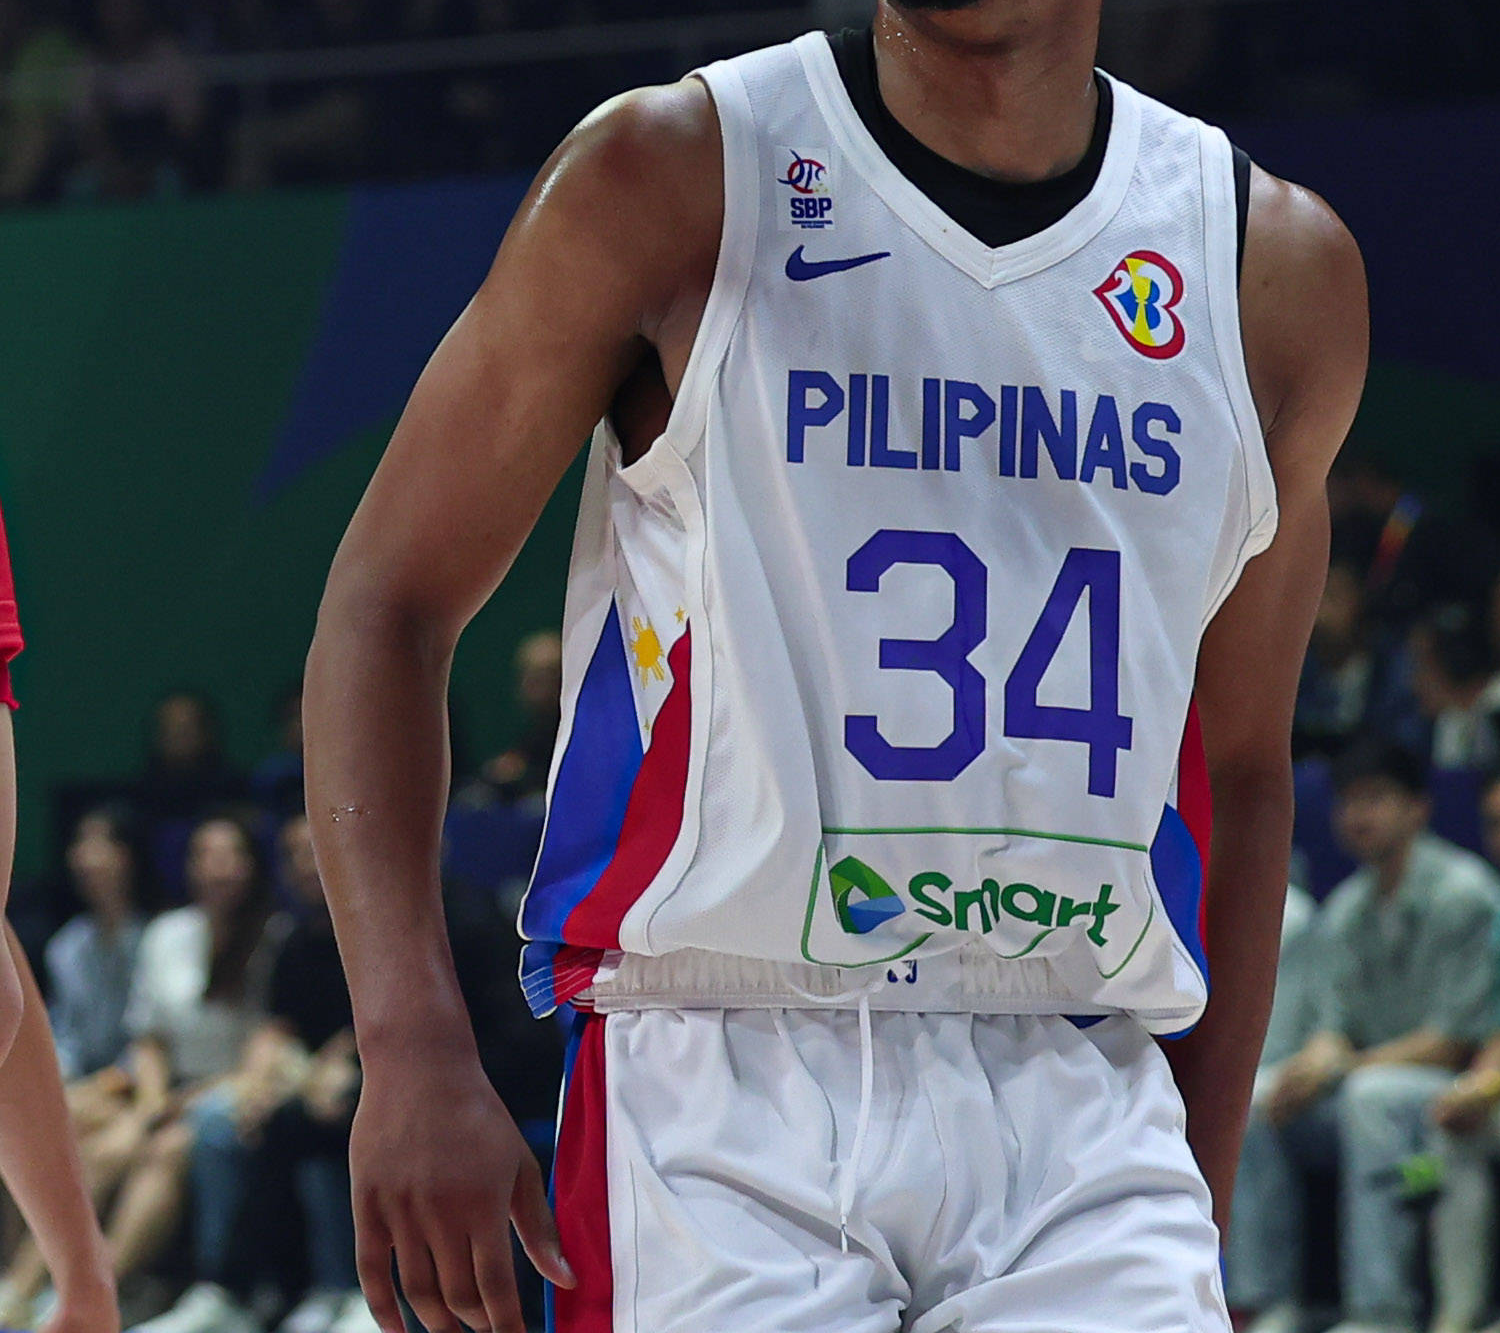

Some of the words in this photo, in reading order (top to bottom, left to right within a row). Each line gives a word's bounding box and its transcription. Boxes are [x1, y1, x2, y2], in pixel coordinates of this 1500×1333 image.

[790, 197, 832, 219] SBP
[786, 369, 1182, 495] PILIPINAS
[843, 528, 1133, 798] 34
[908, 870, 1121, 948] Smart
